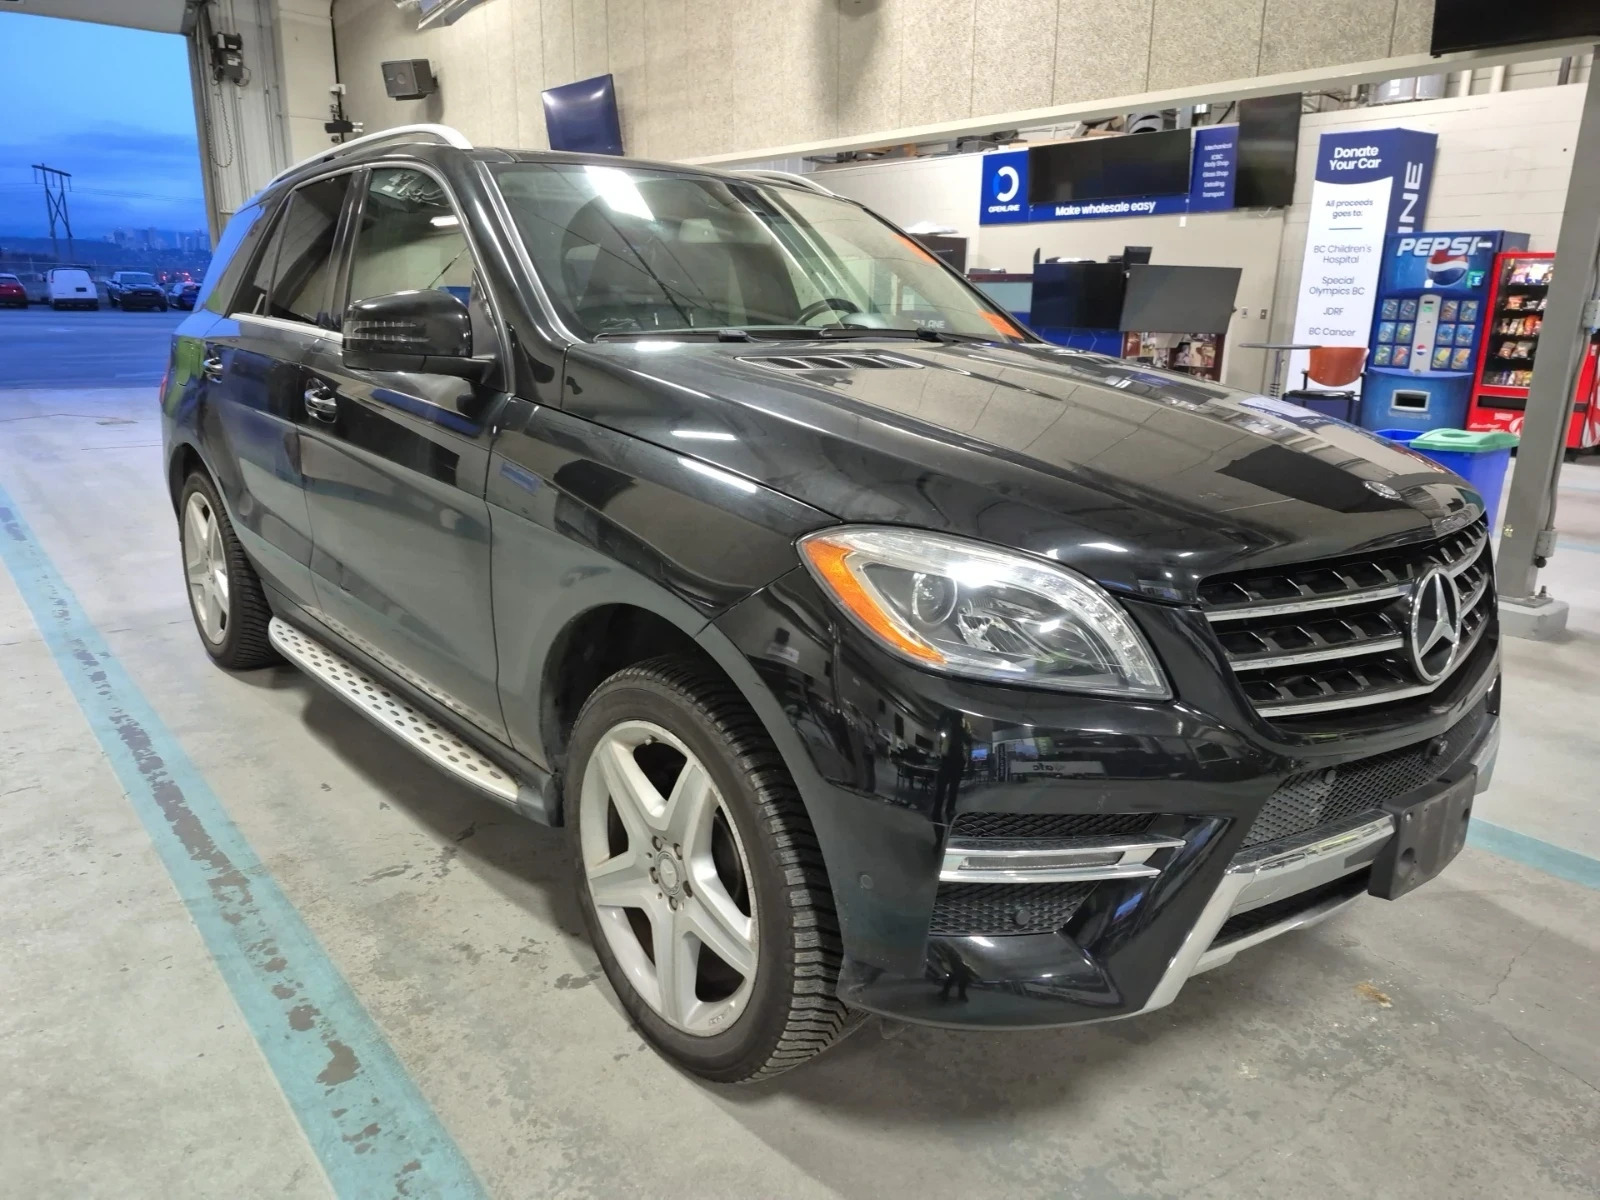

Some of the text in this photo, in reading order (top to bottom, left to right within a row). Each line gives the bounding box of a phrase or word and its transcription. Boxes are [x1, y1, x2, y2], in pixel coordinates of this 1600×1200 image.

[1334, 145, 1379, 158] Donate
[1329, 157, 1382, 170] Your Car
[988, 204, 1021, 213] OPENLANE
[1055, 201, 1156, 216] Make wholesale easy
[1336, 199, 1373, 208] proceeds
[1332, 211, 1351, 219] goes
[1313, 244, 1372, 253] BC Children's
[1396, 236, 1481, 256] PEPSI
[1322, 255, 1360, 266] Hospital
[1322, 276, 1355, 286] Special
[1309, 286, 1365, 297] Olympics BC
[1323, 307, 1344, 315] JDRF
[1308, 327, 1356, 337] BC Cancer
